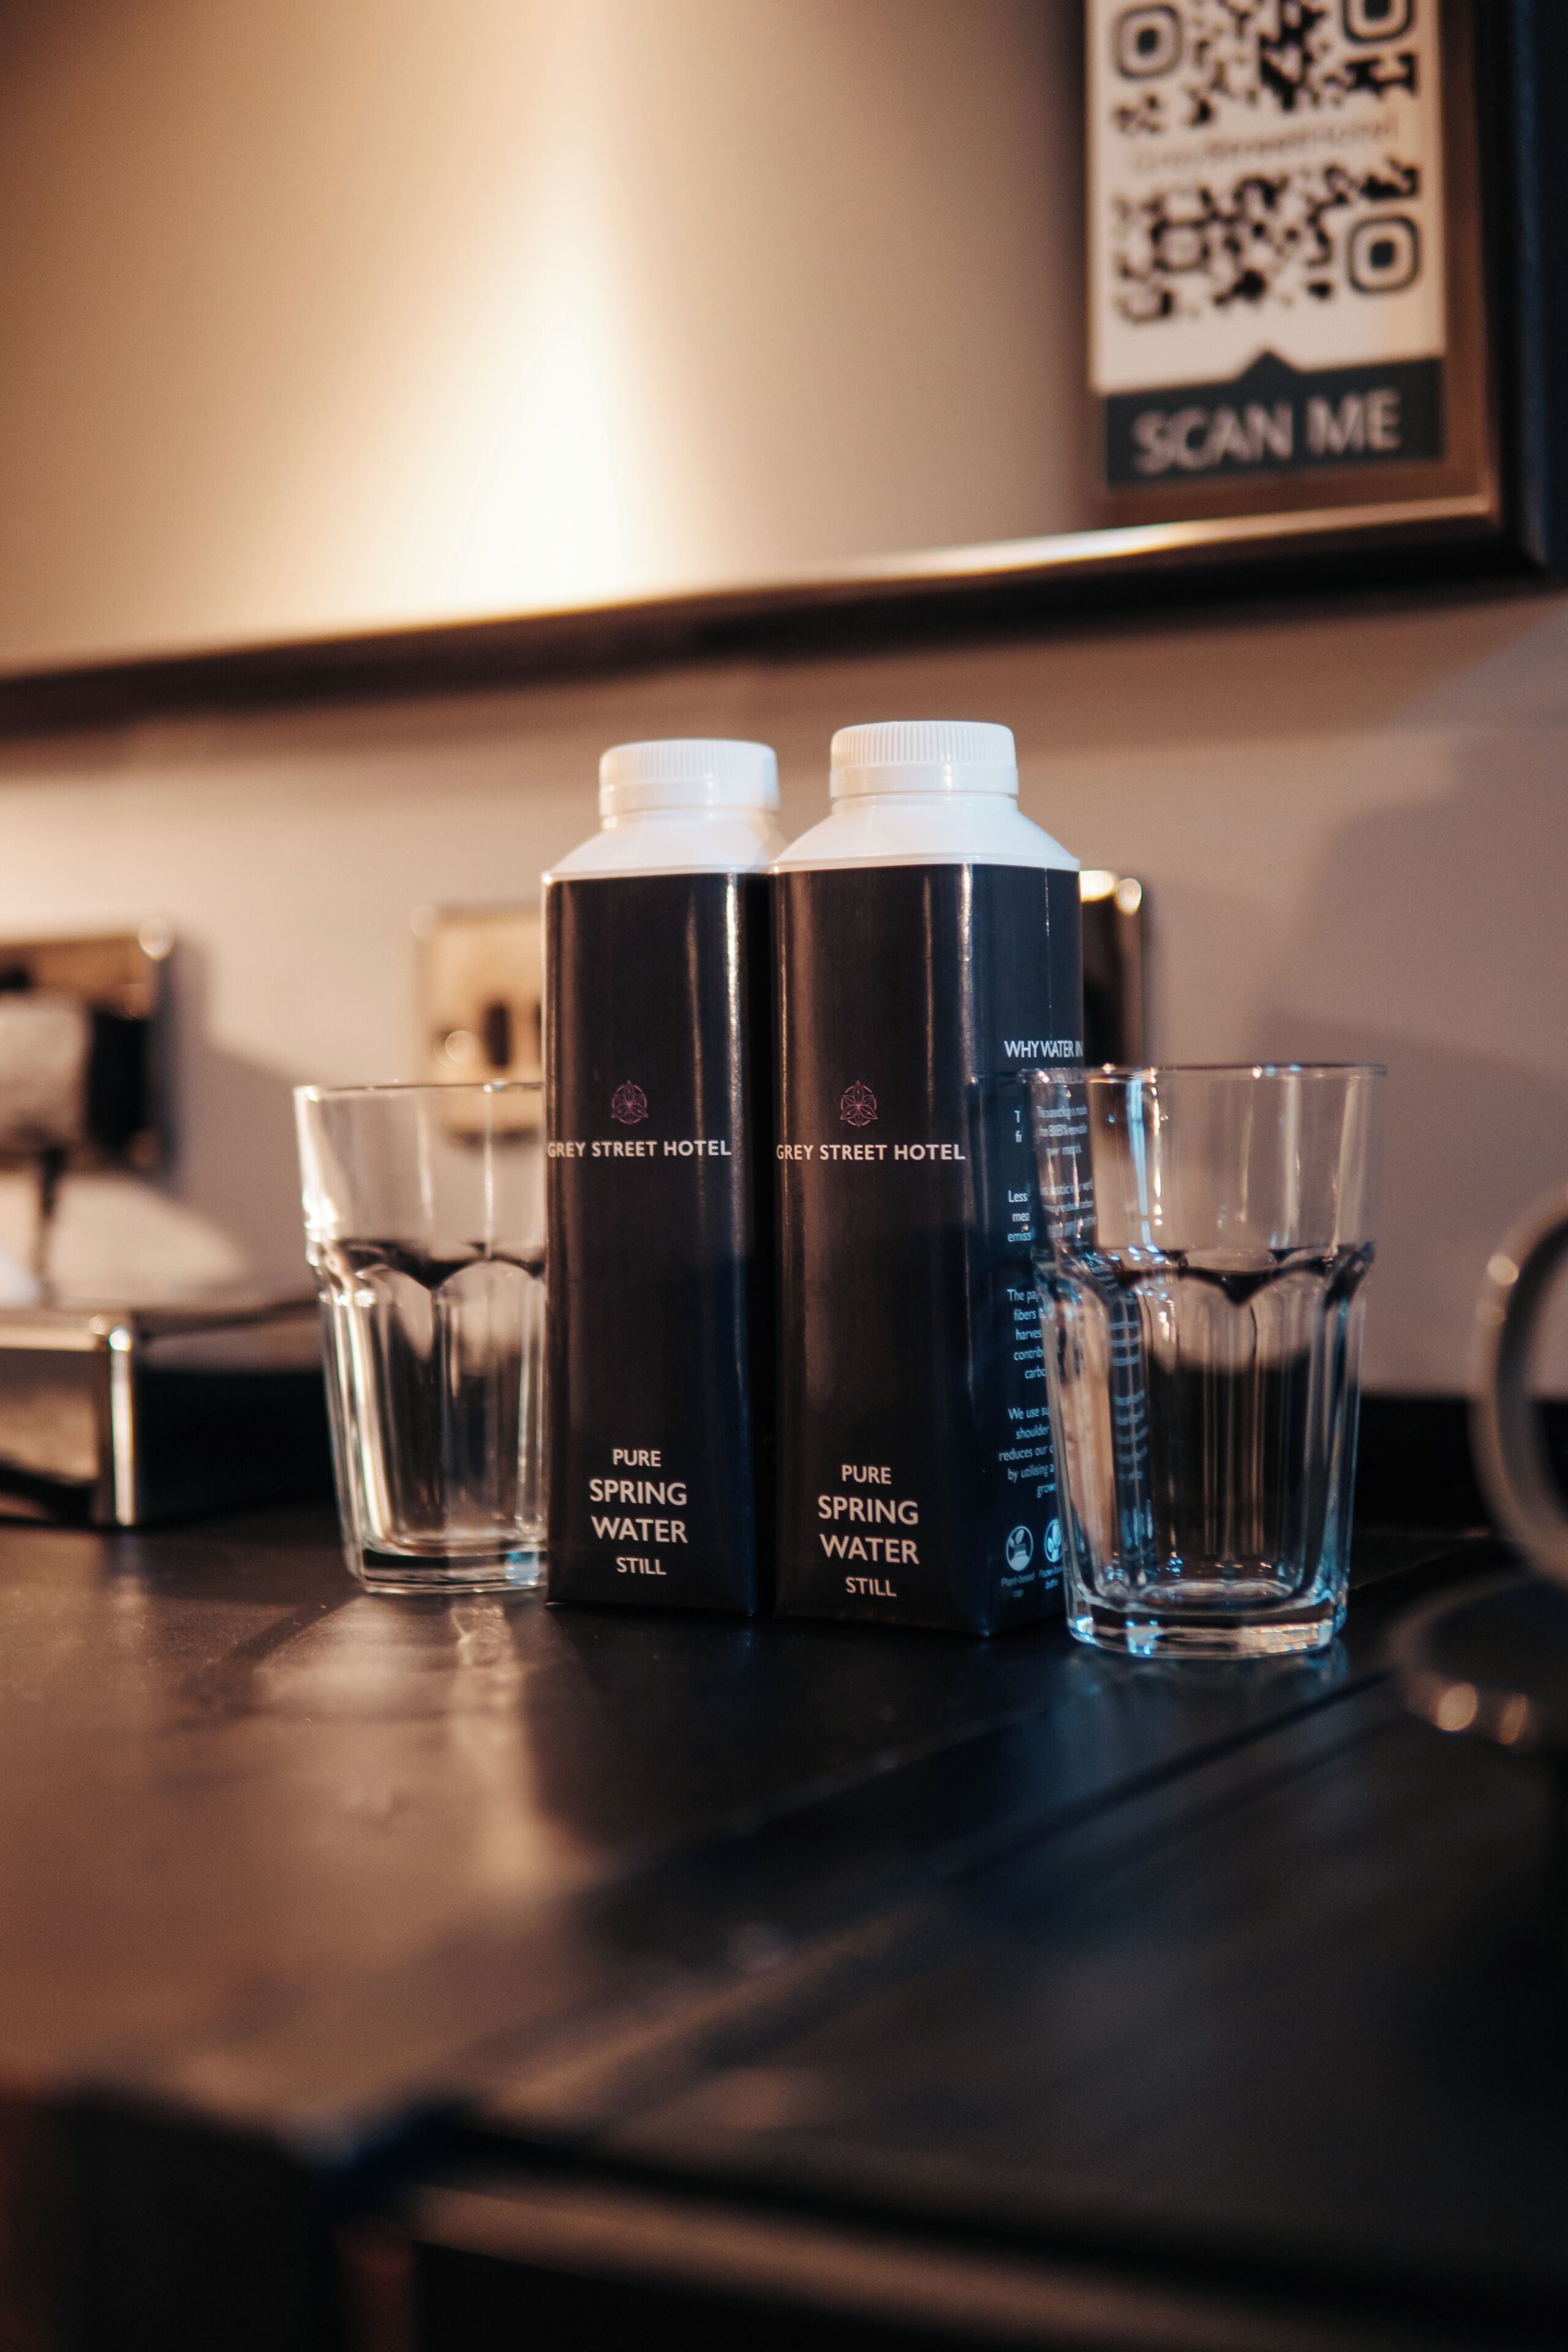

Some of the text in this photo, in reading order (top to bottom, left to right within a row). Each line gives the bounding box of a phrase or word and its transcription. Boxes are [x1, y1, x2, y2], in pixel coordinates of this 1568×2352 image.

[1132, 387, 1401, 474] SCAN ME
[1004, 1040, 1040, 1058] WHY
[1041, 1040, 1074, 1058] WATER
[547, 1140, 733, 1158] GREY STREET HOTEL
[776, 1144, 967, 1161] GREY STREET HOTEL
[1008, 1189, 1028, 1203] Less
[1012, 1212, 1030, 1223] mea
[1008, 1232, 1033, 1243] emiss
[1006, 1289, 1025, 1302] The
[1014, 1308, 1036, 1321] fibers
[1016, 1329, 1042, 1341] harves
[1014, 1346, 1044, 1361] contrib
[1025, 1365, 1047, 1379] carbo
[1008, 1408, 1025, 1420] We
[1026, 1408, 1039, 1418] use
[1016, 1423, 1049, 1439] shoulder
[613, 1449, 662, 1468] PURE
[998, 1447, 1033, 1462] reduces
[1035, 1445, 1049, 1456] our
[842, 1464, 892, 1485] PURE
[1008, 1468, 1019, 1483] by
[589, 1478, 687, 1506] SPRING
[818, 1495, 919, 1525] SPRING
[590, 1515, 688, 1544] WATER
[819, 1533, 920, 1564] WATER
[616, 1557, 667, 1575] STILL
[845, 1577, 897, 1597] STILL
